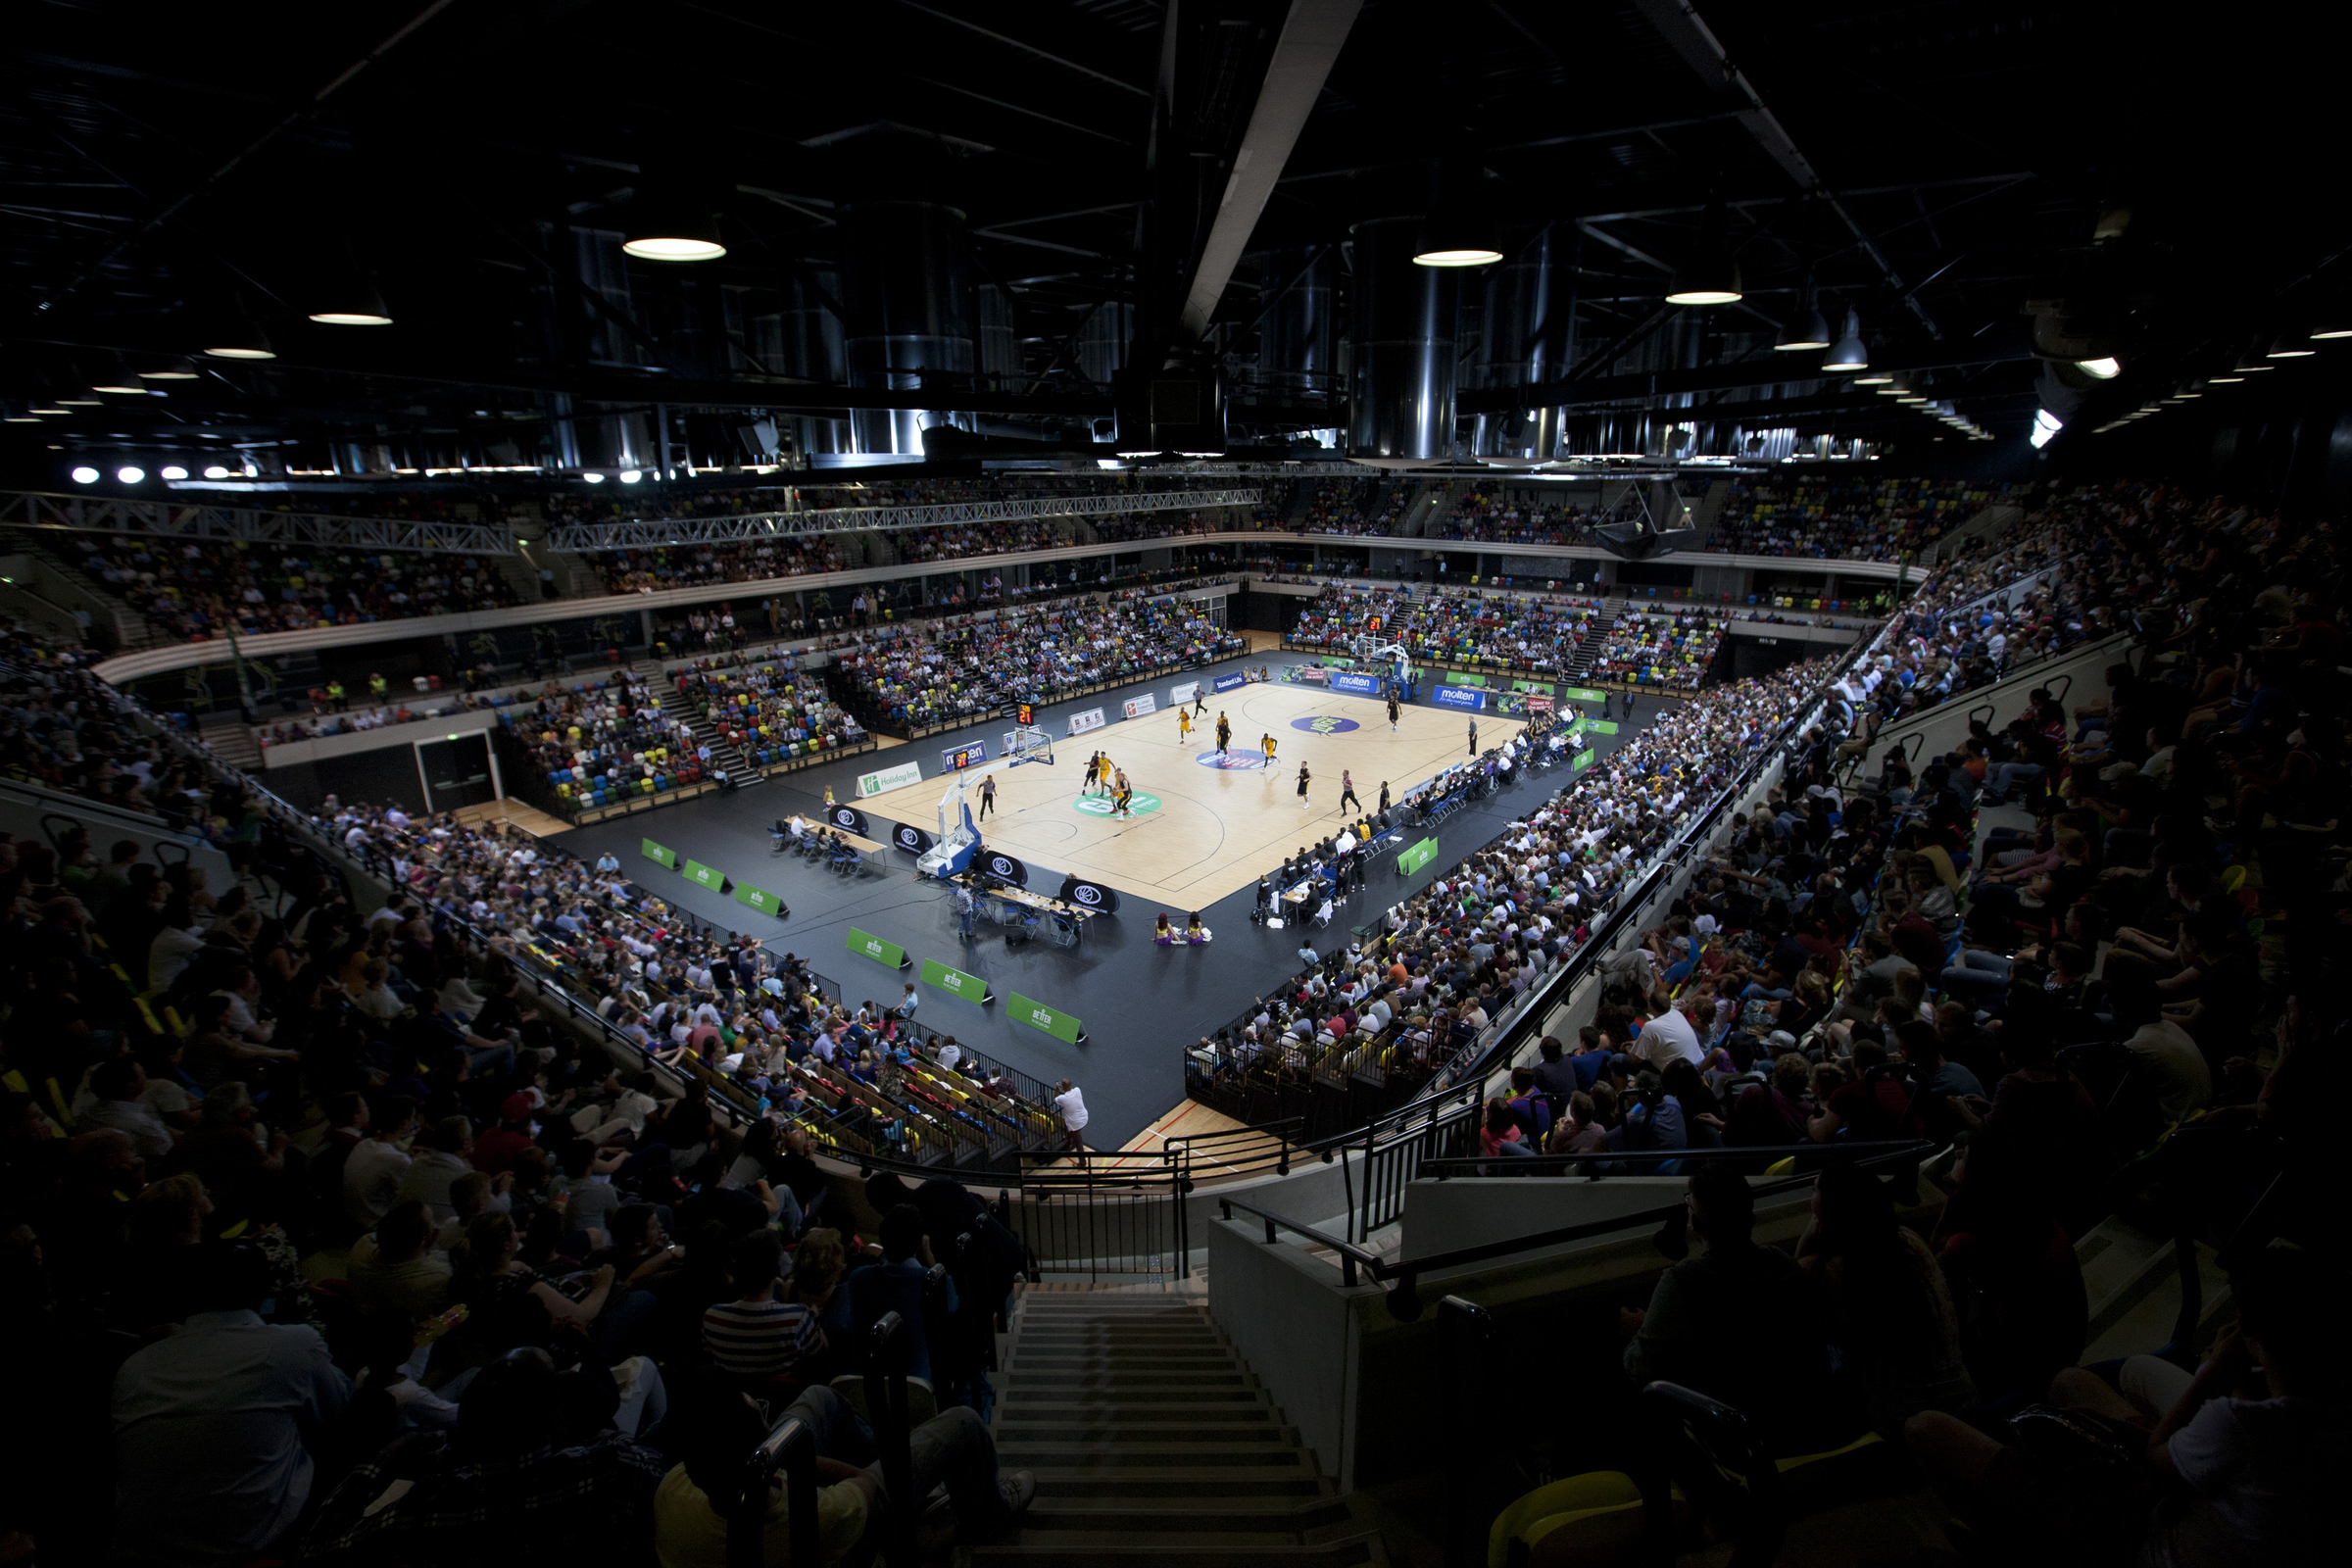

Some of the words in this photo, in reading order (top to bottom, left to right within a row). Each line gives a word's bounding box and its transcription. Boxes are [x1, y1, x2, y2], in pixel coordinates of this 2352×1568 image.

[1340, 676, 1370, 686] molten
[1442, 689, 1475, 701] molten
[1019, 710, 1030, 723] 21
[881, 773, 906, 786] Holiday
[866, 940, 882, 954] BETTER
[944, 973, 962, 988] BETTER
[1032, 1008, 1052, 1025] BETTER
